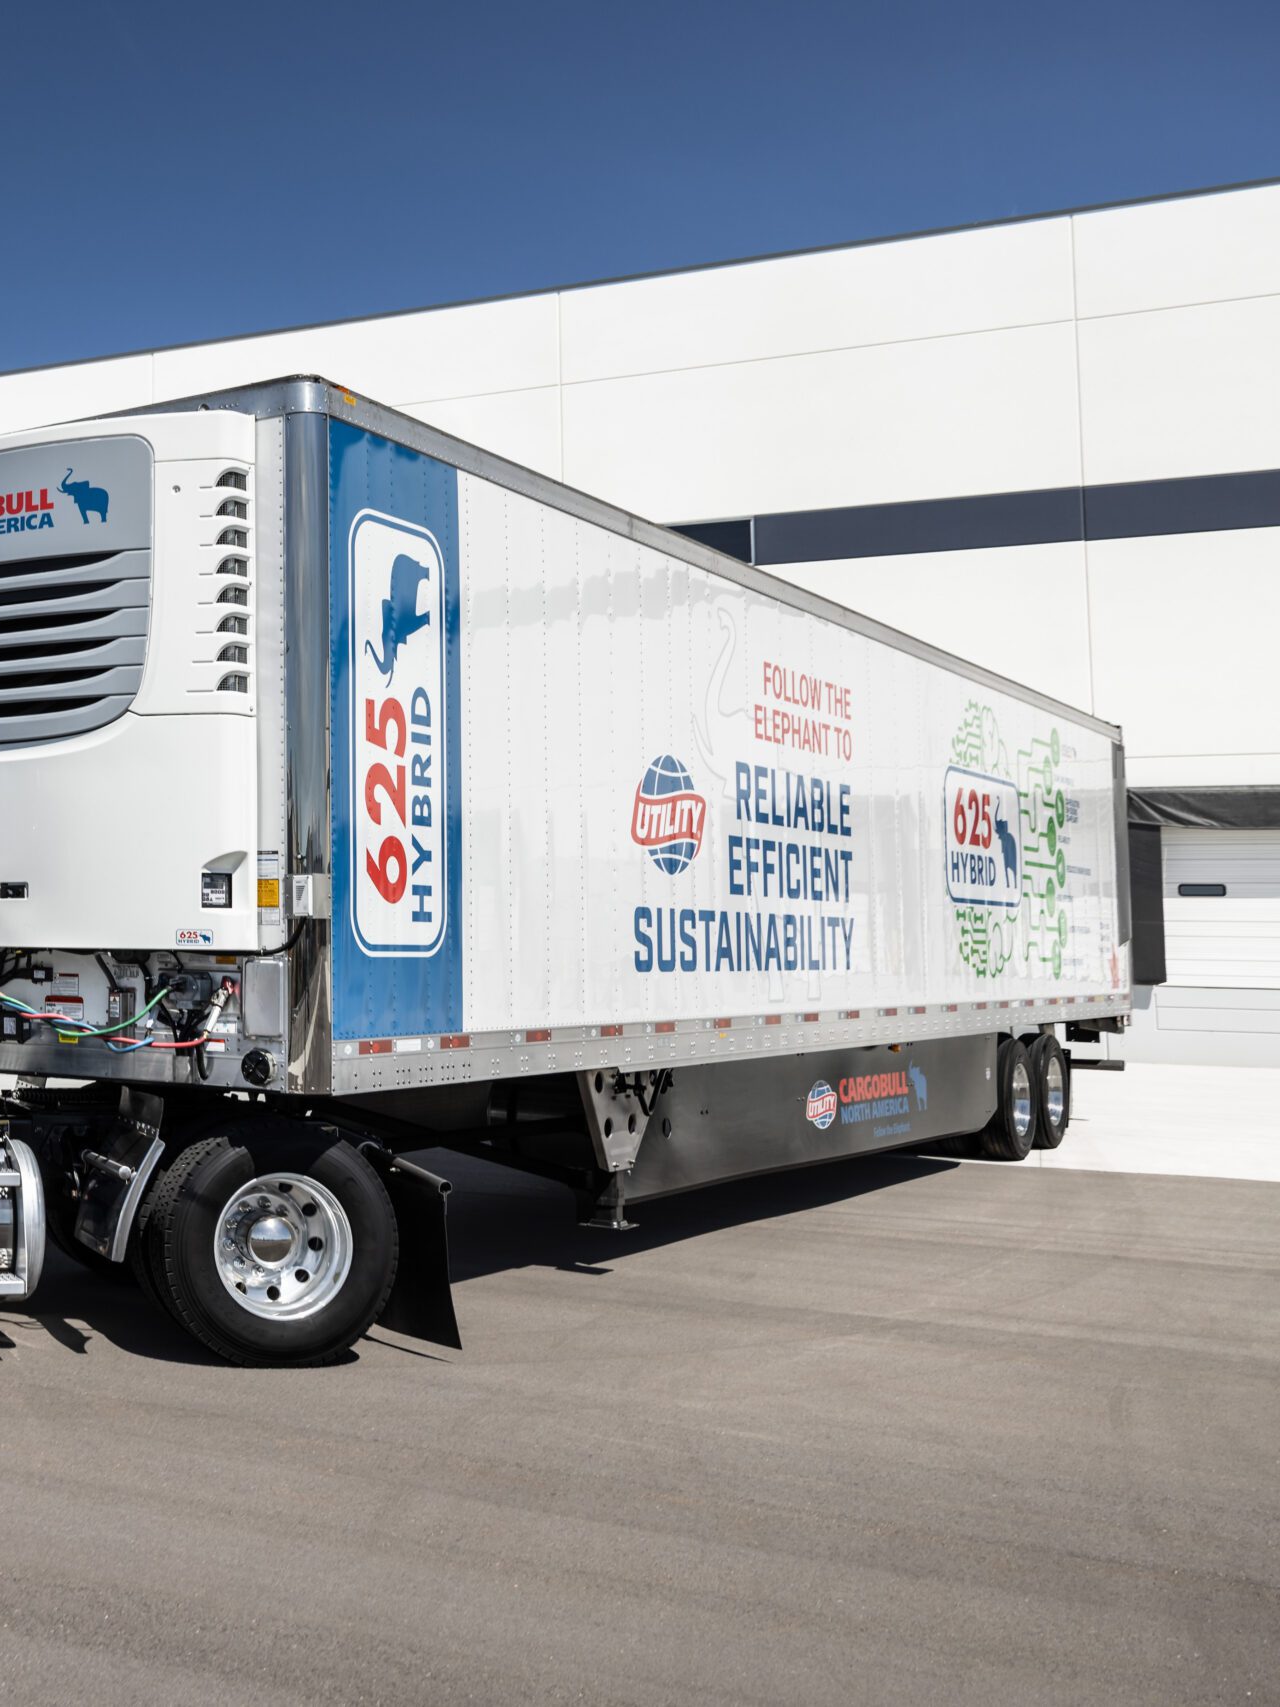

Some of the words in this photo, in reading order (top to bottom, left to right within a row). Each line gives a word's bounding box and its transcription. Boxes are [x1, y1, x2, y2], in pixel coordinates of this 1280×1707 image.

[763, 661, 822, 711] FOLLOW
[825, 682, 852, 720] THE
[754, 704, 831, 756] ELEPHANT
[834, 727, 852, 762] TO
[365, 697, 407, 904] 625
[411, 686, 432, 923] HYBRID
[635, 799, 704, 839] UTILITY
[735, 761, 852, 837] RELIABLE
[953, 787, 992, 850] 625
[728, 835, 853, 904] EFFICIENT
[951, 850, 996, 887] HYBRID
[179, 931, 198, 939] 625
[634, 906, 855, 973] SUSTAINABILITY
[808, 1095, 836, 1118] UTILITY
[839, 1071, 909, 1104] CARGOBULL
[841, 1102, 871, 1125] NORTH
[871, 1096, 910, 1119] AMERICA
